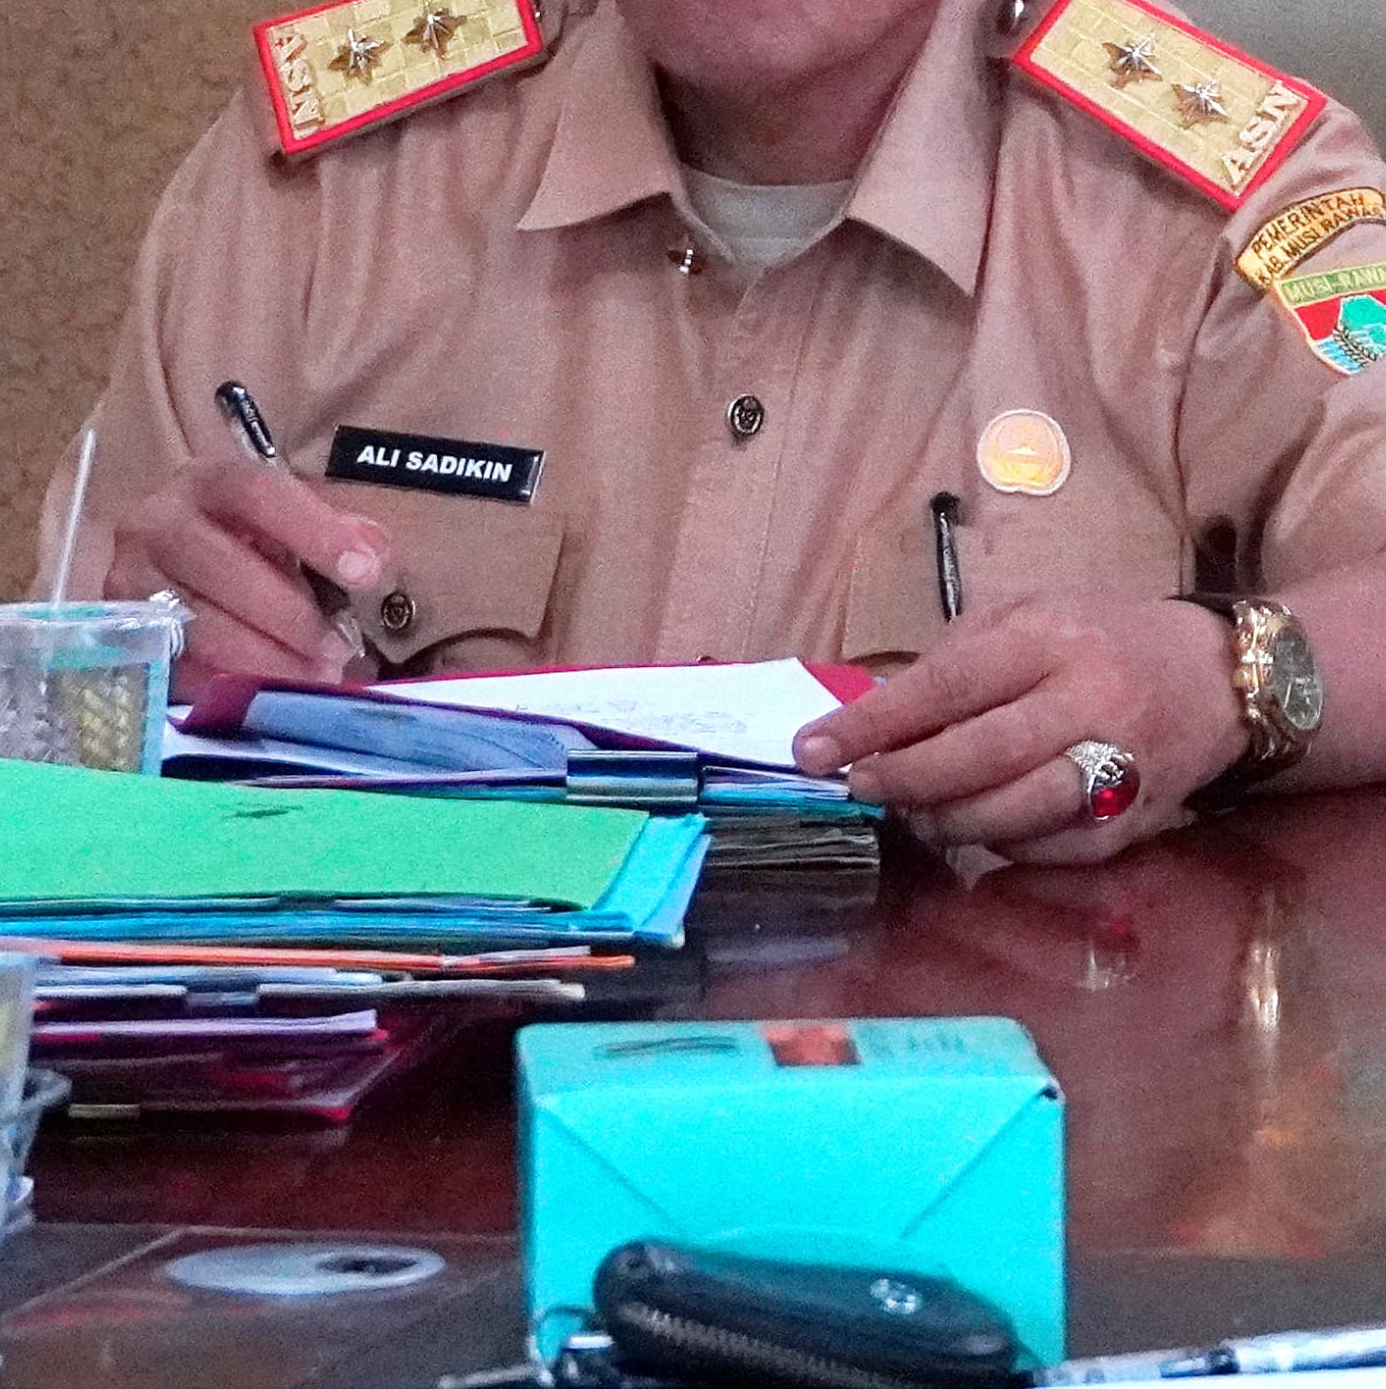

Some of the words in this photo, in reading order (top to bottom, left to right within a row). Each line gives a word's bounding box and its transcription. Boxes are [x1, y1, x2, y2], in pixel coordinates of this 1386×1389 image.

[1221, 79, 1302, 187] ASN
[1251, 193, 1365, 260] PEMERINTAH
[1281, 227, 1321, 260] MUSI
[357, 445, 400, 467] ALI
[405, 451, 512, 483] SADIKIN
